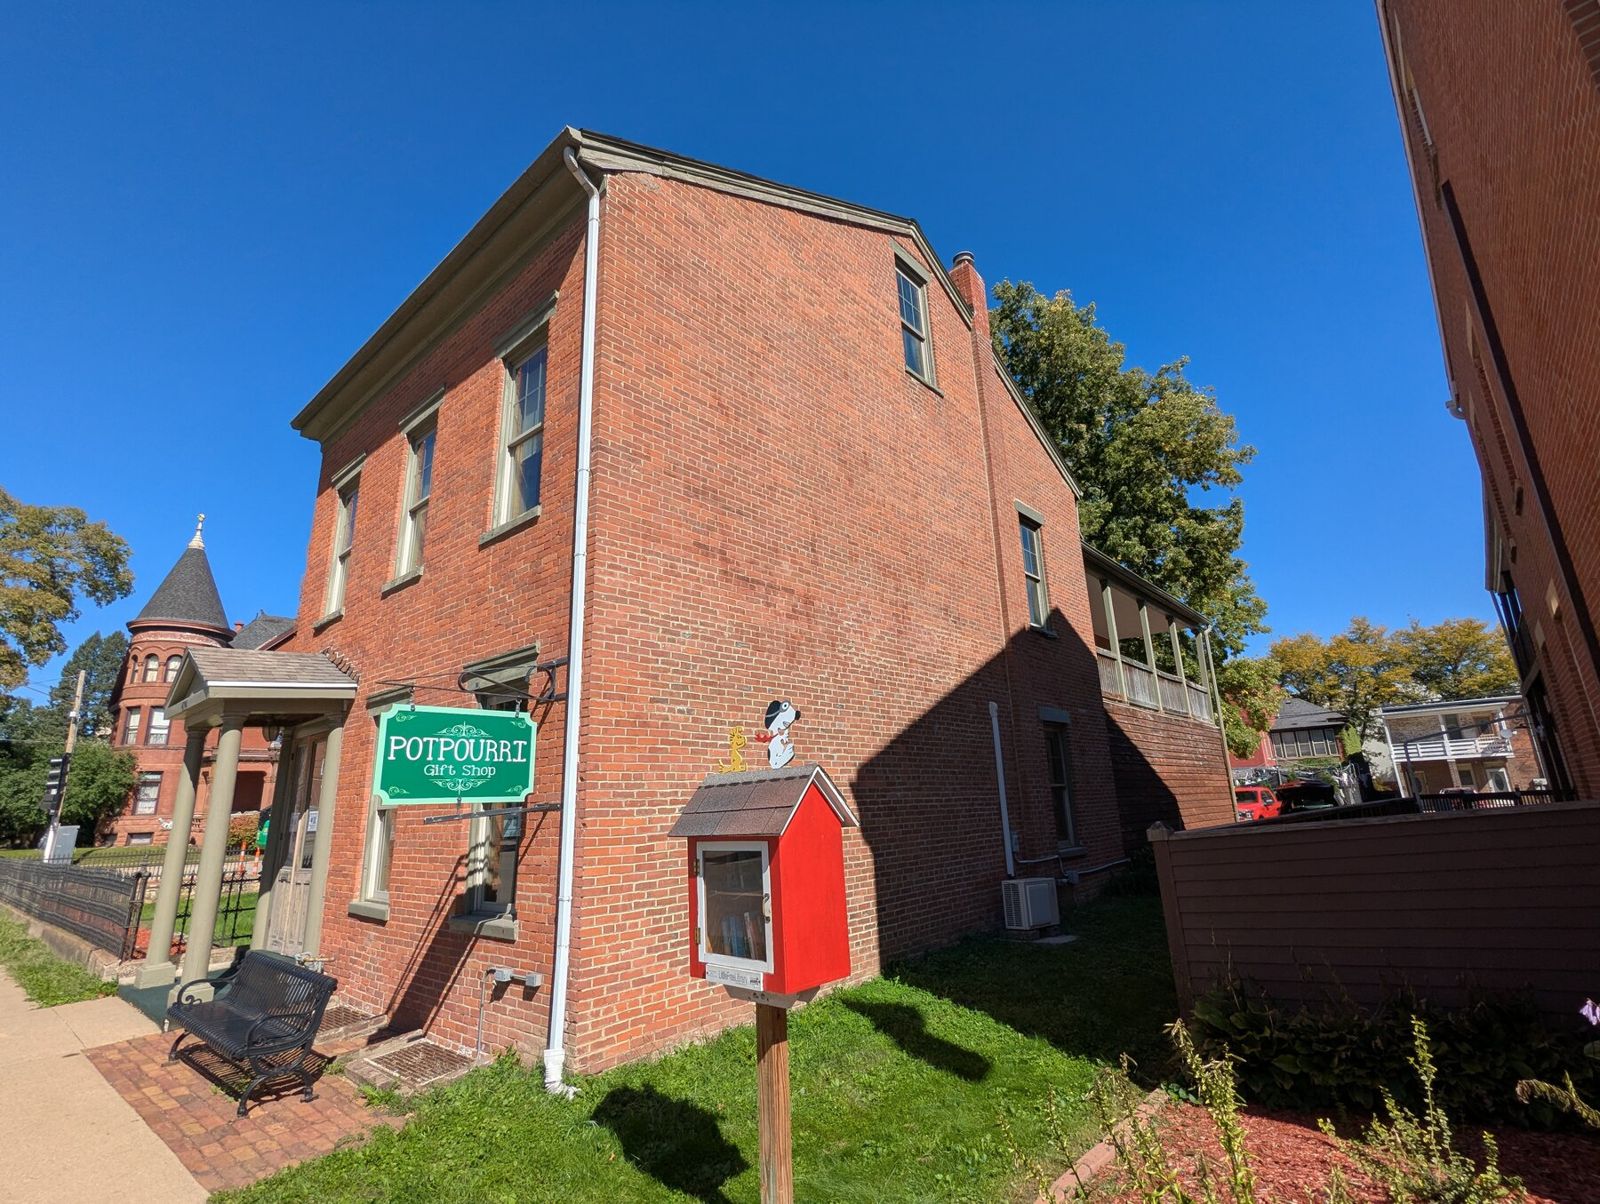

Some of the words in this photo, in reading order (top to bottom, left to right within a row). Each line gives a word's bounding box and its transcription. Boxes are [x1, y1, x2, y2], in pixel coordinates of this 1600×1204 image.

[388, 736, 527, 762] POTPOURRI
[424, 764, 456, 777] Gift
[462, 764, 496, 778] Shop
